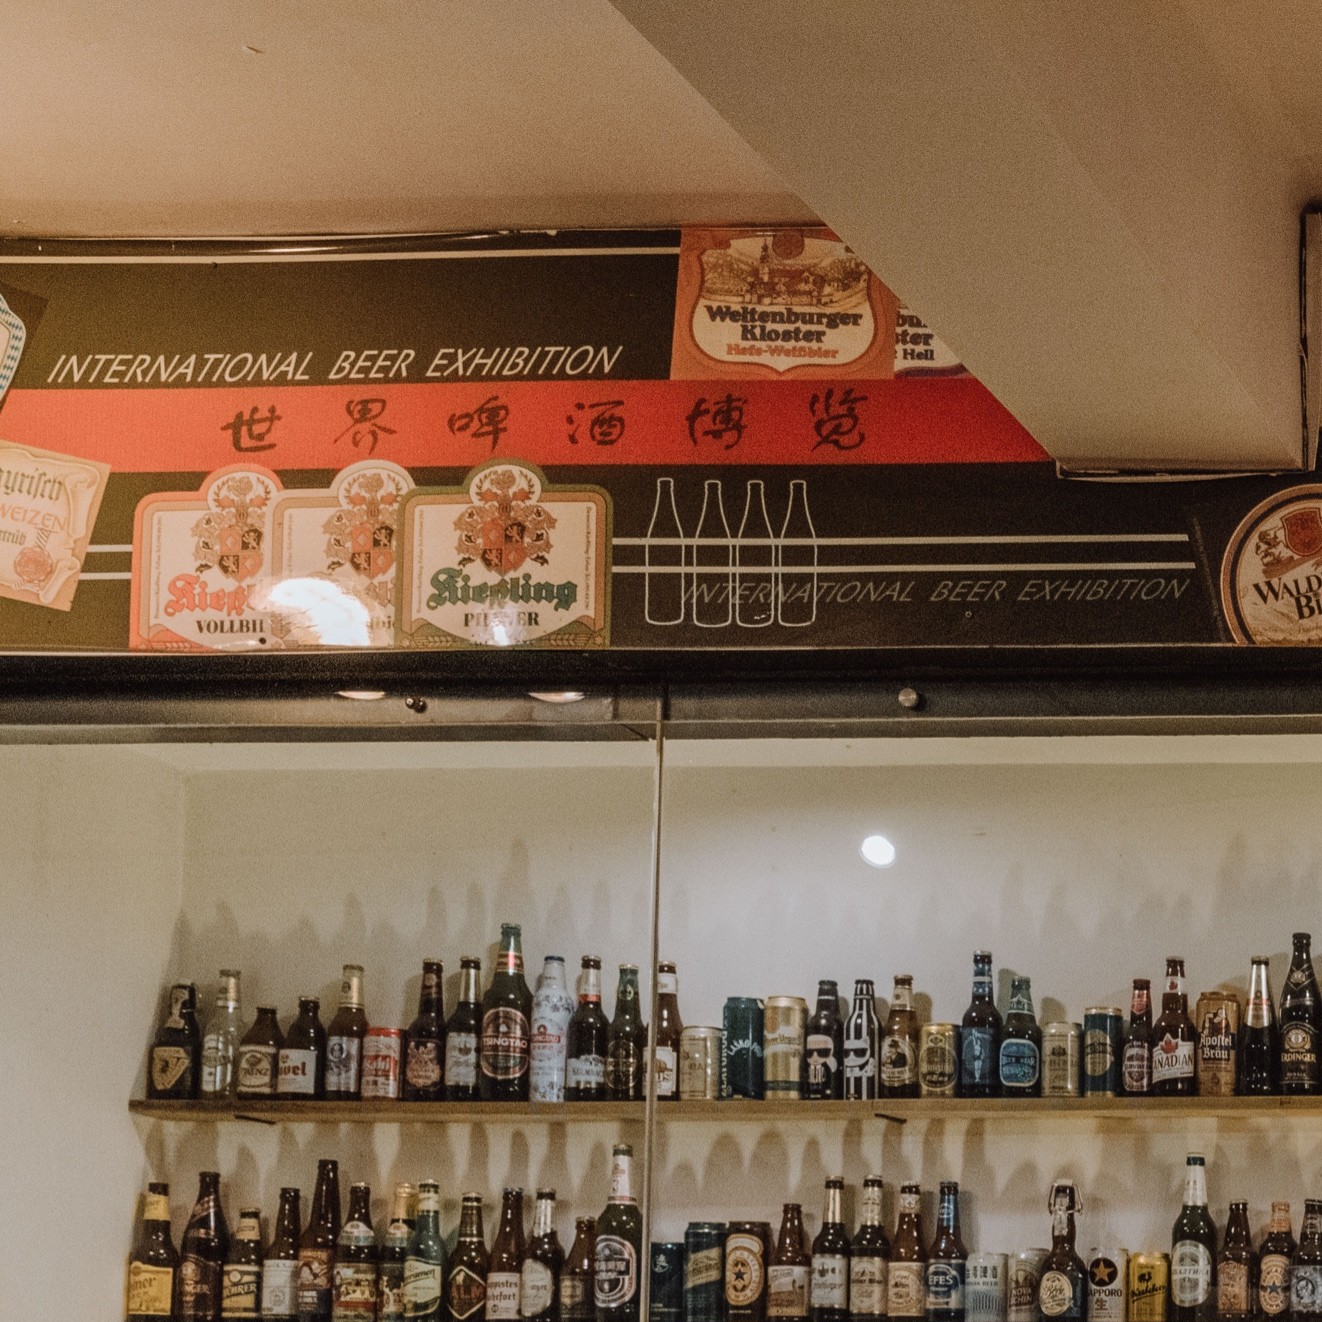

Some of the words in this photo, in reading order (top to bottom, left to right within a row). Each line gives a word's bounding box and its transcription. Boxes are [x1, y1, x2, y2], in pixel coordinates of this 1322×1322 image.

[705, 305, 863, 330] Weltenburger
[739, 324, 827, 344] Kloster
[46, 350, 315, 384] INTERNATIONAL
[328, 347, 416, 381] BEER
[425, 344, 624, 379] EXHIBITION
[683, 580, 915, 606] INTERNATIONAL
[929, 579, 1007, 603] BEER
[1017, 577, 1190, 602] EXHIBITION
[928, 1274, 953, 1286] EFES
[1087, 1288, 1123, 1297] APPORO
